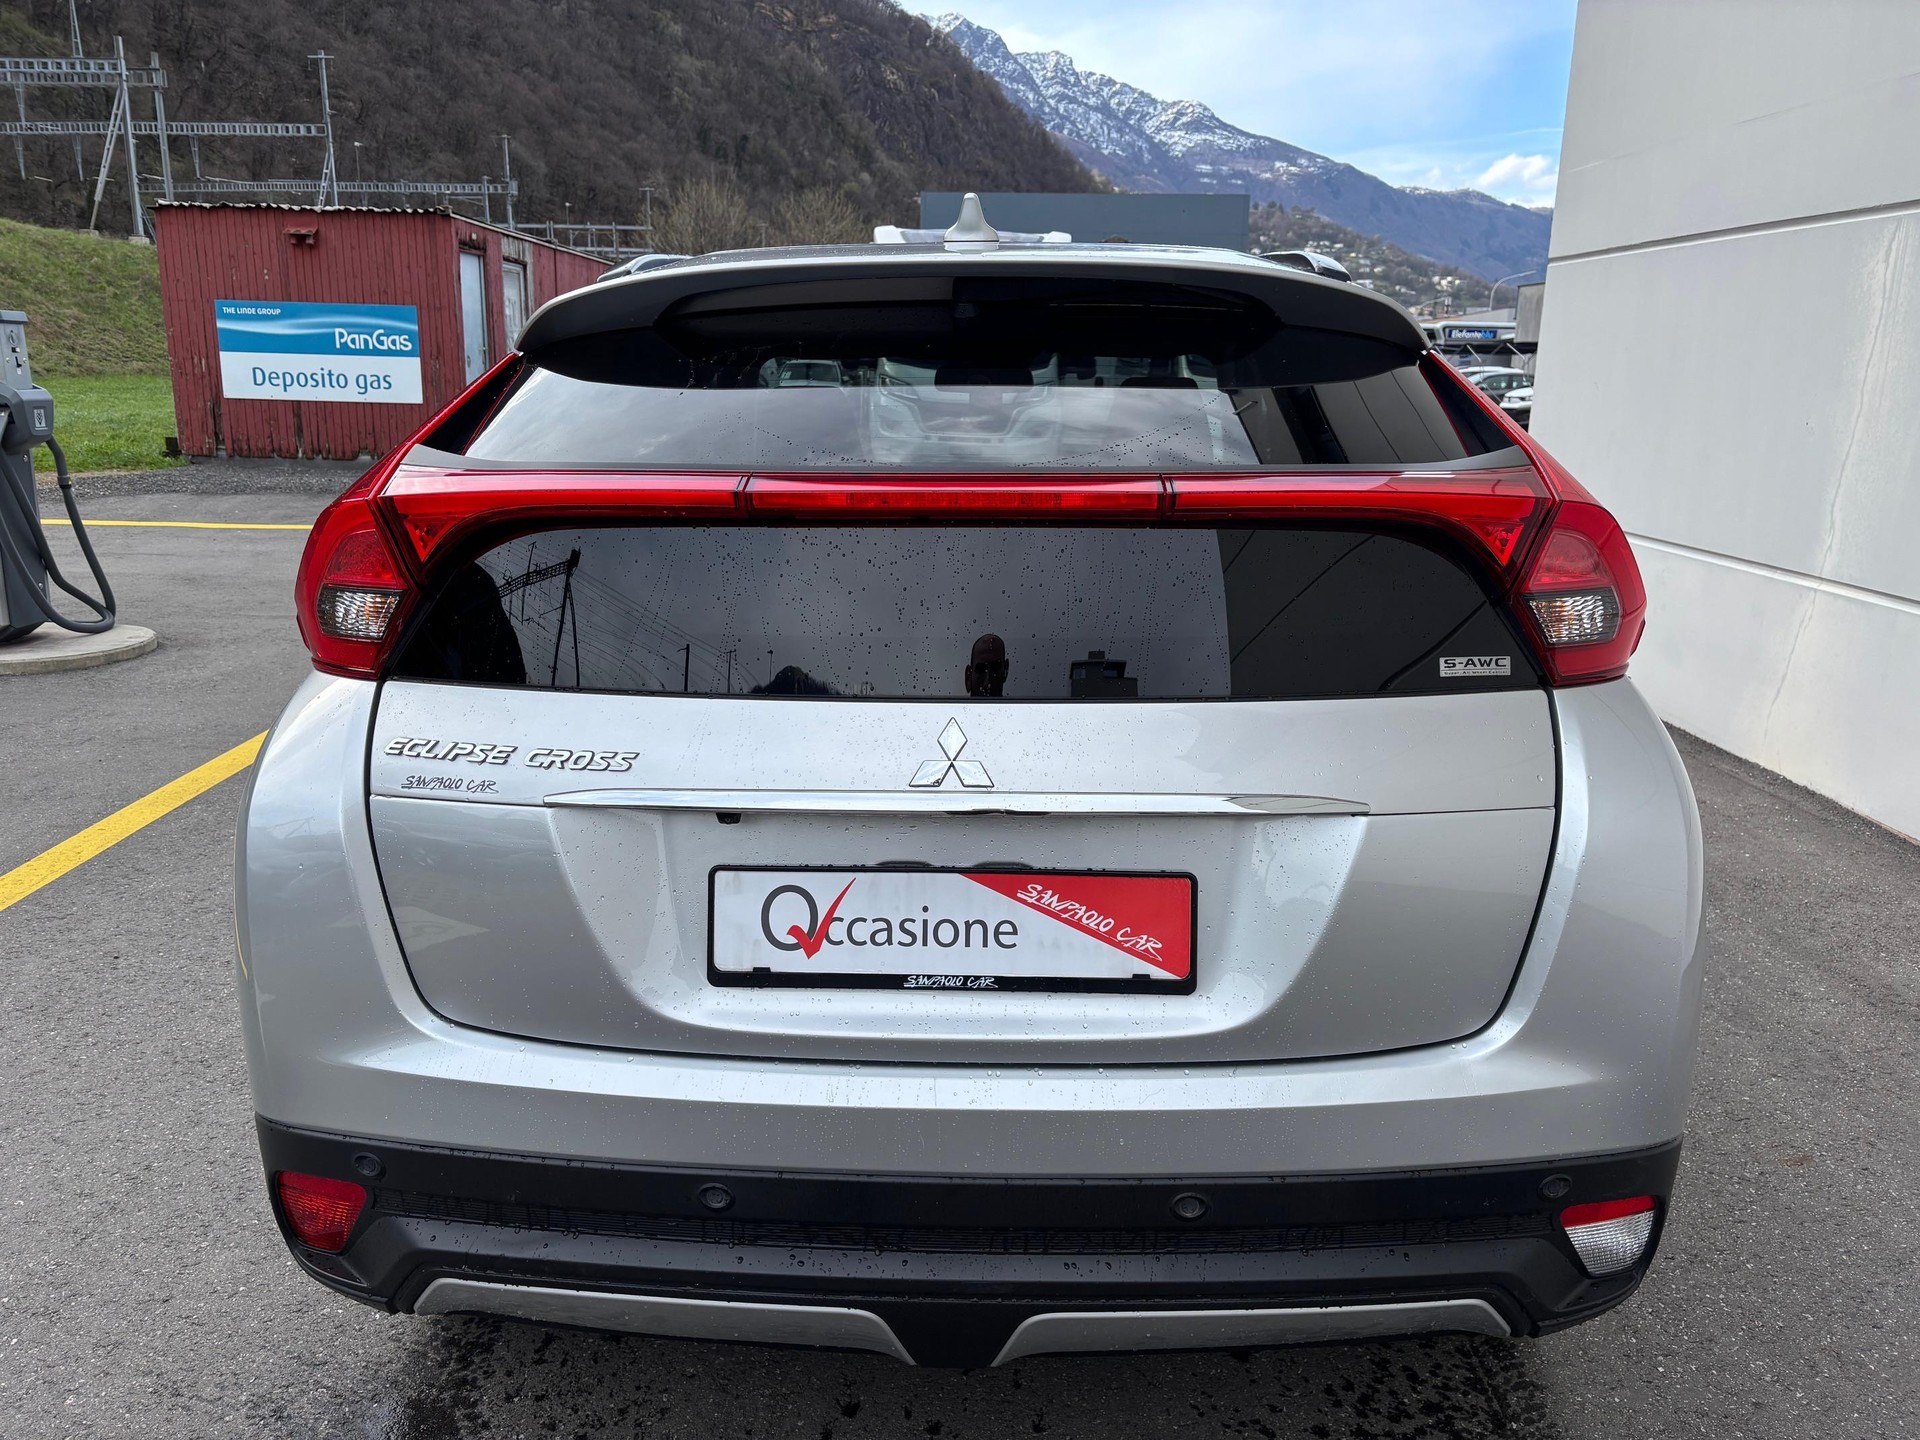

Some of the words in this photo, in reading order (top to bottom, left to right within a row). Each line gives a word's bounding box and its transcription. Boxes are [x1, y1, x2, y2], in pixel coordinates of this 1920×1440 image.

[237, 307, 256, 315] LINDE
[257, 308, 281, 316] GROUP
[334, 328, 413, 351] PanGas
[252, 367, 348, 392] Deposito
[355, 373, 392, 395] gas
[1444, 658, 1507, 669] S-AWC
[384, 737, 518, 765] ECLIPSE
[523, 748, 640, 772] CROSS
[401, 776, 463, 790] SANPAOLO
[466, 779, 499, 793] CAR
[1017, 884, 1114, 932] SANPAOLO
[1116, 927, 1162, 961] CAR
[903, 975, 963, 988] SANPAOLO
[966, 976, 998, 988] CAR
